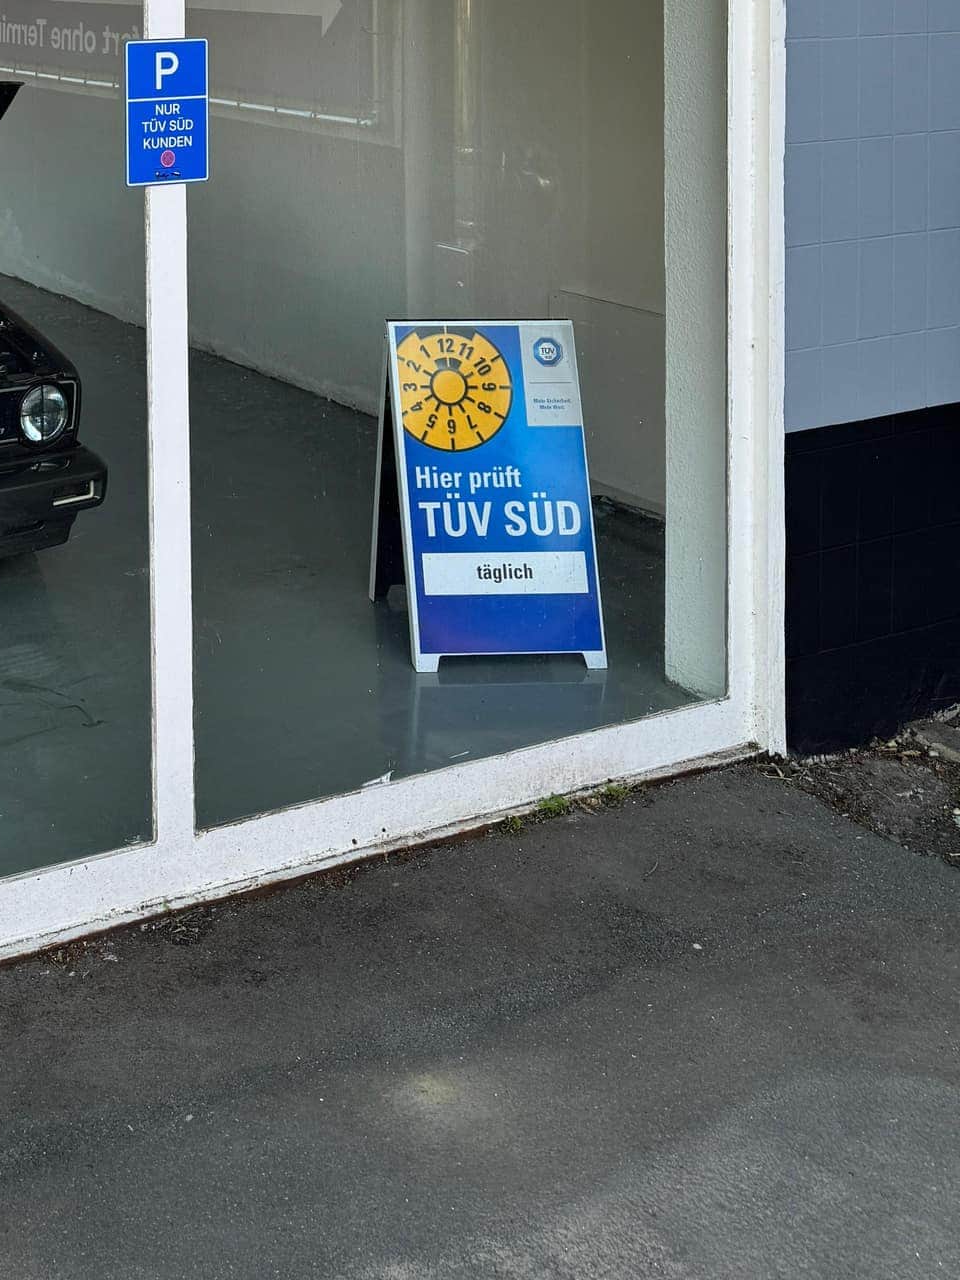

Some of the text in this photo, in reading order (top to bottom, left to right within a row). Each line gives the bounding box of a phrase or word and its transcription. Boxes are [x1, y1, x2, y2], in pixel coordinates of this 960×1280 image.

[156, 51, 179, 90] P
[155, 103, 181, 115] NUR
[142, 117, 194, 133] TÜV SÜD
[143, 136, 193, 150] KUNDEN
[420, 345, 431, 358] 1
[437, 338, 454, 353] 12
[459, 343, 474, 360] 11
[406, 360, 421, 372] 2
[474, 357, 492, 376] 10
[403, 383, 417, 392] 3
[482, 383, 497, 392] 9
[410, 401, 423, 412] 4
[477, 402, 492, 414] 8
[426, 414, 438, 429] 5
[447, 419, 456, 434] 6
[466, 414, 477, 429] 7
[415, 466, 522, 494] Hier prüft
[418, 492, 582, 537] TÜV SÜD
[476, 563, 533, 583] täglich
